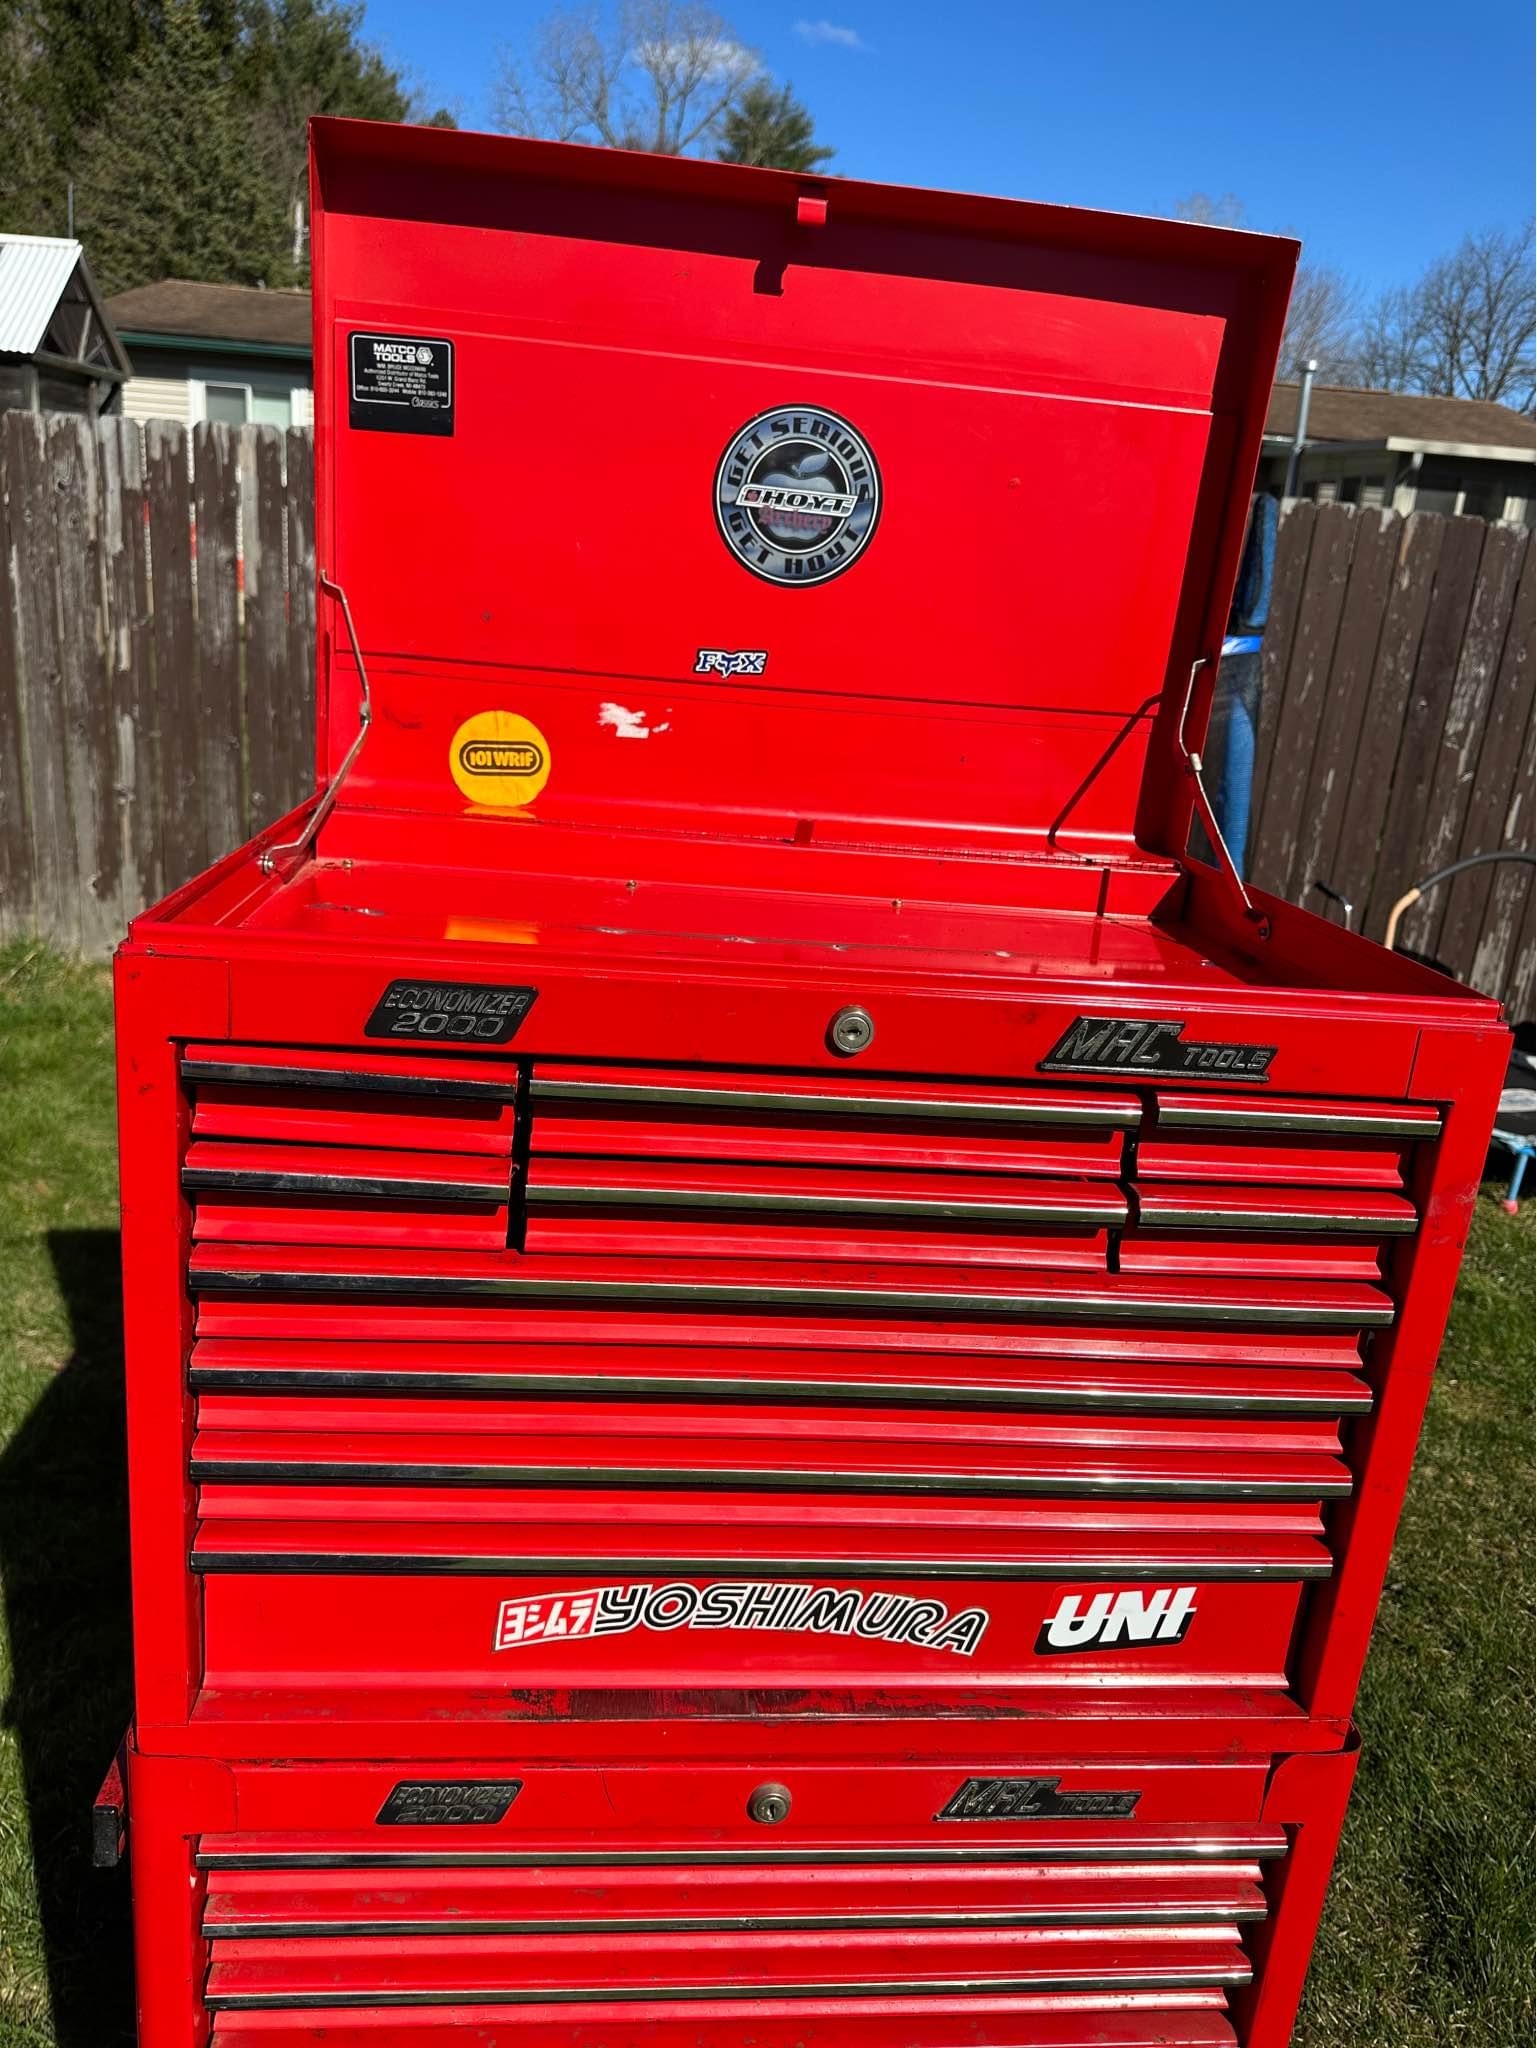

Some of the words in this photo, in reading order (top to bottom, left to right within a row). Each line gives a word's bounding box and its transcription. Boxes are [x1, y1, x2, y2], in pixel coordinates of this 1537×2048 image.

[373, 343, 416, 355] MATCO
[374, 352, 416, 364] TOOLS
[727, 430, 764, 487] GET
[770, 417, 870, 499] SERIOUS
[761, 490, 852, 513] HOYT
[758, 505, 832, 534] Archery
[729, 511, 773, 564] GET
[784, 525, 859, 574] HOYT
[469, 751, 492, 766] 101
[493, 751, 534, 767] WRIF
[384, 987, 529, 1015] ECONOMIZER
[391, 1012, 504, 1037] 2000
[1055, 1020, 1181, 1063] MAC
[1183, 1047, 1271, 1070] TOOLS
[503, 1598, 594, 1642] ヨシムラ
[595, 1585, 988, 1654] YOSHIMURA
[1042, 1586, 1198, 1647] UNI
[392, 1786, 518, 1805] ECONOMIZER
[950, 1781, 1058, 1813] MAC
[1059, 1795, 1137, 1811] TOOLS
[396, 1804, 496, 1823] 2000
